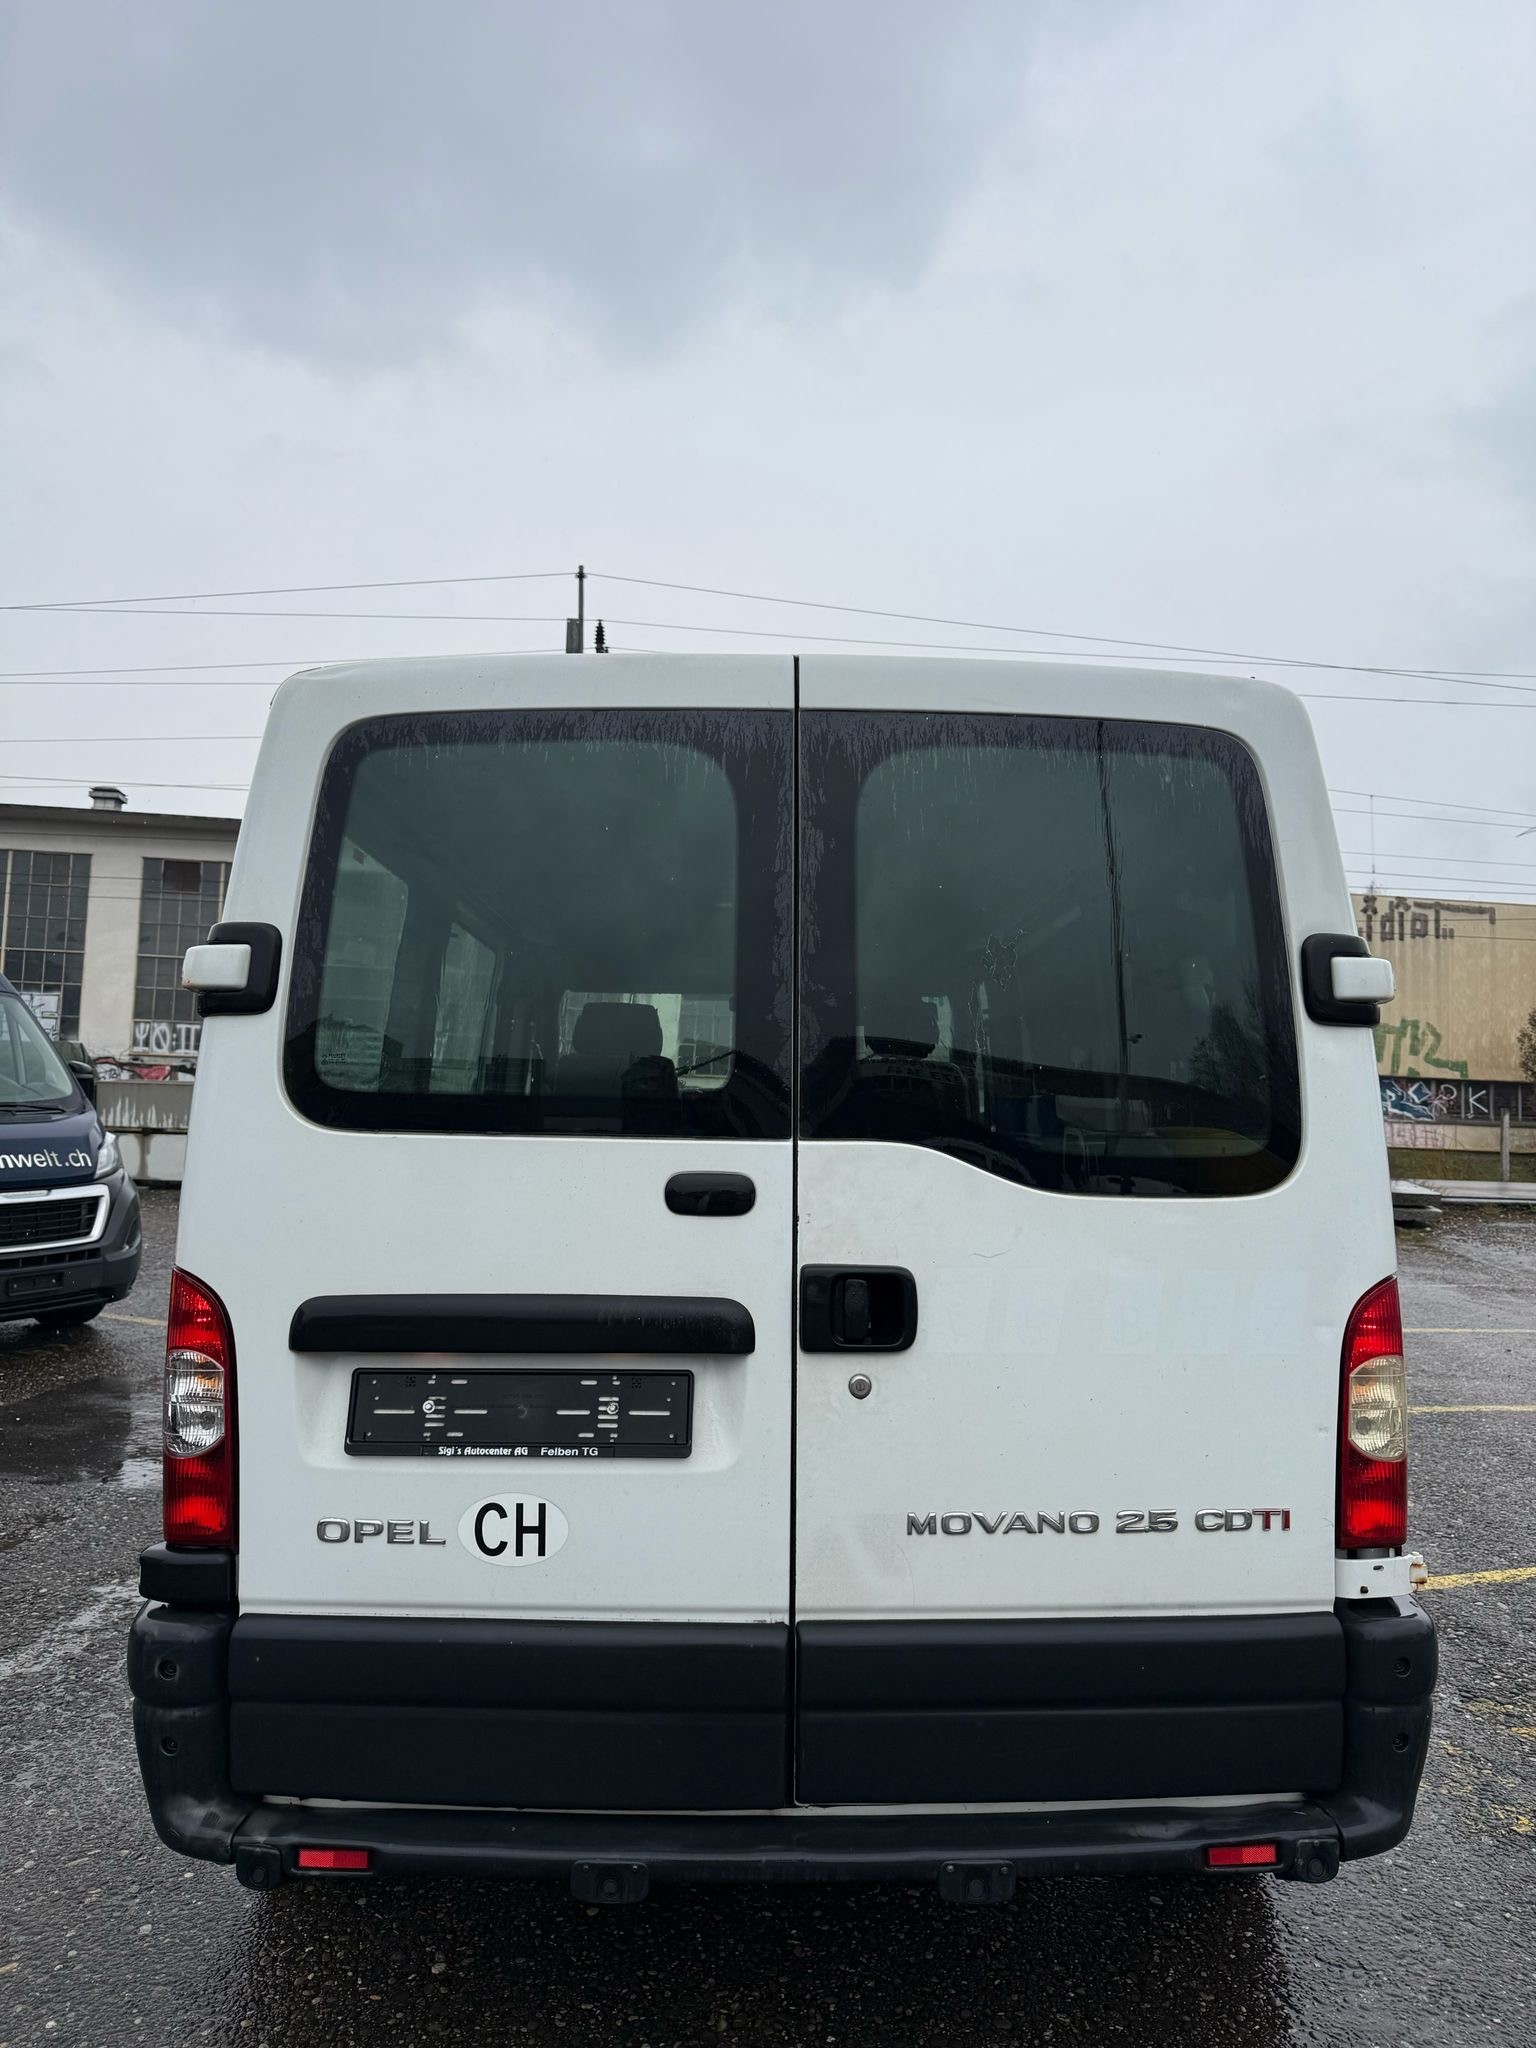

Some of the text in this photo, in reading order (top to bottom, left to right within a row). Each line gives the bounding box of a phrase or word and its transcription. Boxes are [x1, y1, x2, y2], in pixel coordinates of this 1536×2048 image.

[464, 1446, 512, 1456] Autocenter
[514, 1446, 528, 1456] AG
[540, 1447, 579, 1456] Felben
[582, 1447, 599, 1456] TG
[316, 1517, 447, 1545] OPEL
[474, 1502, 547, 1557] CH
[906, 1511, 1100, 1536] MOVANO
[1194, 1507, 1291, 1532] CDTI
